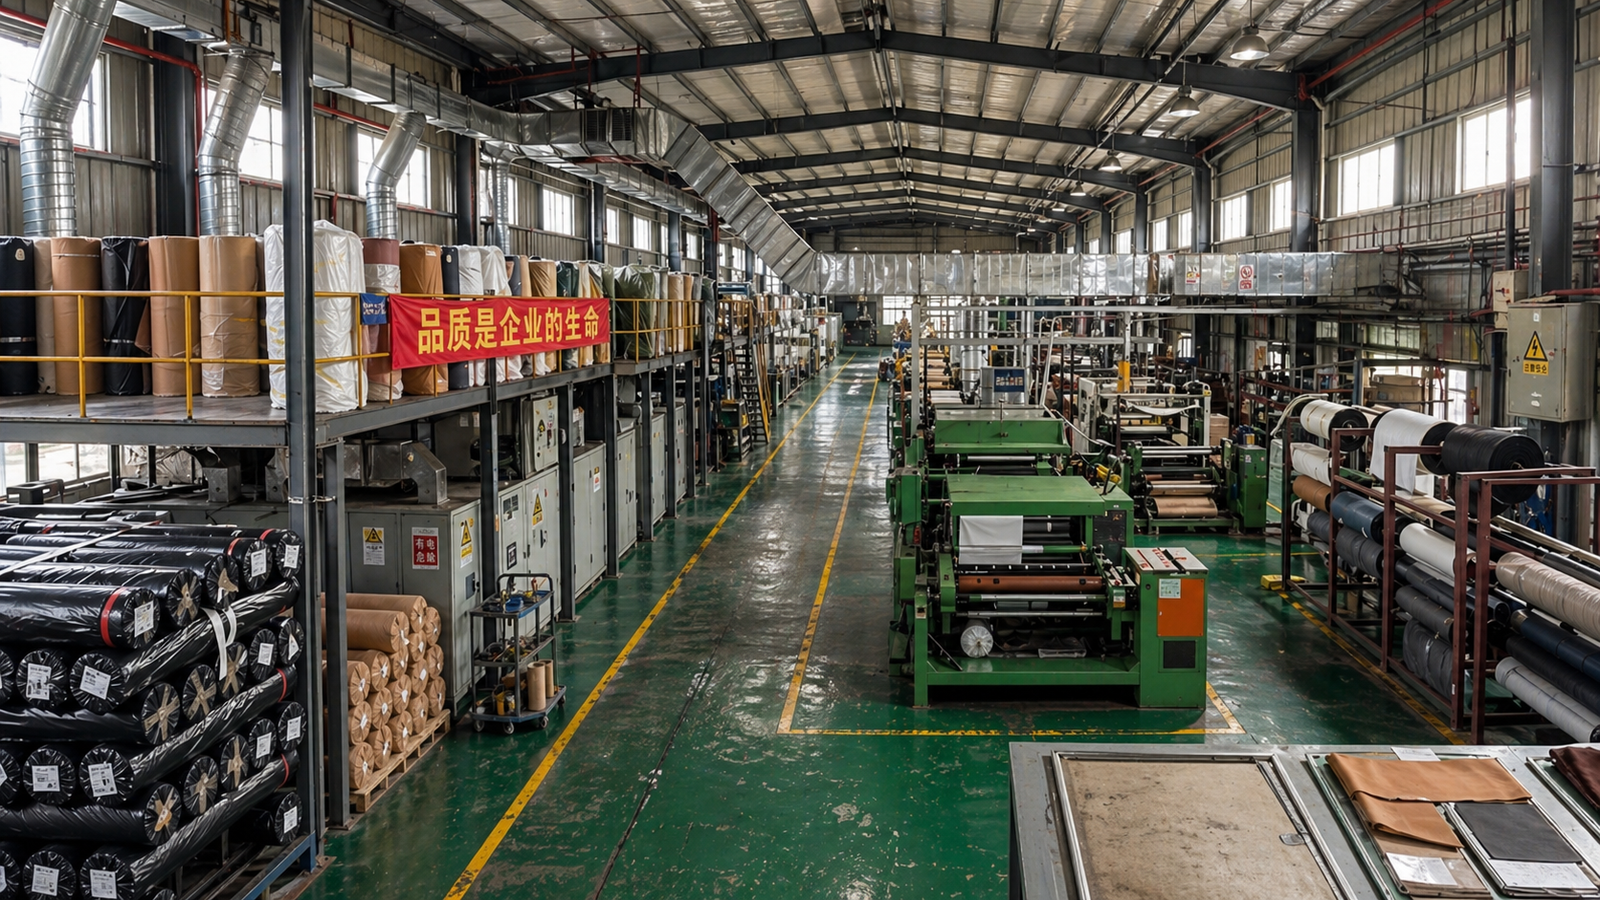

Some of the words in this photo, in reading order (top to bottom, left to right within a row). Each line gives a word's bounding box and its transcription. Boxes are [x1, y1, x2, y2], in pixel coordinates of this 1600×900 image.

[418, 305, 599, 355] 品质是企业的生命
